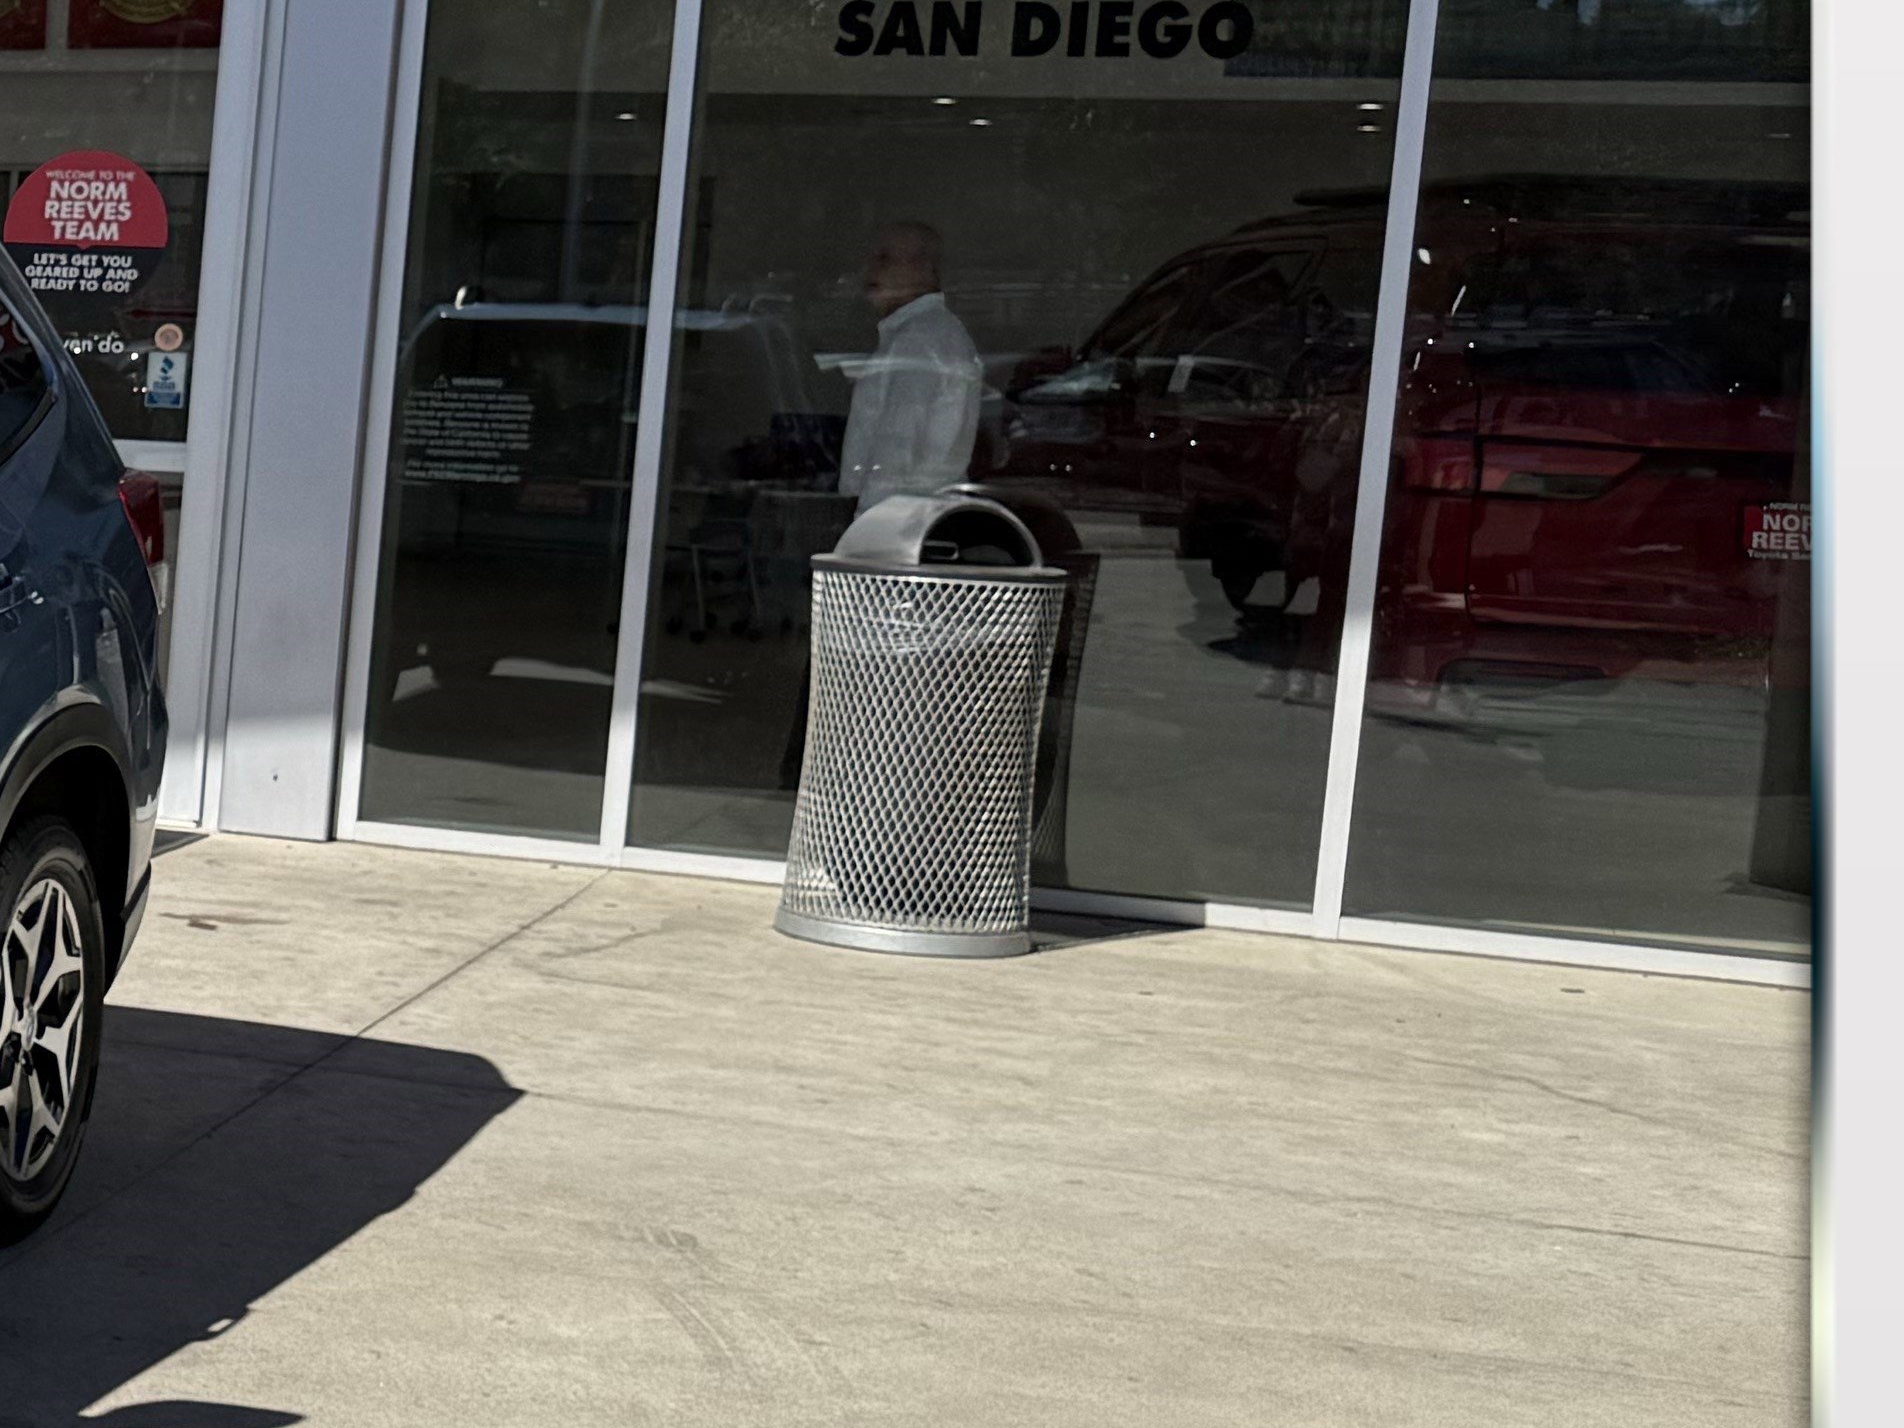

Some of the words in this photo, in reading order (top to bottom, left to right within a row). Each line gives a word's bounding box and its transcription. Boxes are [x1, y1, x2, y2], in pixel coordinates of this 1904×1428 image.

[1010, 0, 1255, 60] DIEGO
[46, 169, 96, 181] WELCOME
[99, 170, 113, 181] TO
[116, 171, 136, 182] THE
[50, 180, 128, 201] NORM
[44, 200, 132, 222] REEVES
[50, 220, 120, 241] TEAM
[33, 252, 68, 266] LET'S
[71, 253, 98, 267] GET
[101, 255, 133, 268] YOU
[24, 265, 80, 278] GEARED
[82, 267, 104, 279] UP
[105, 268, 139, 281] AND
[30, 277, 75, 291] READY
[79, 279, 99, 292] TO
[101, 280, 130, 293] GO!
